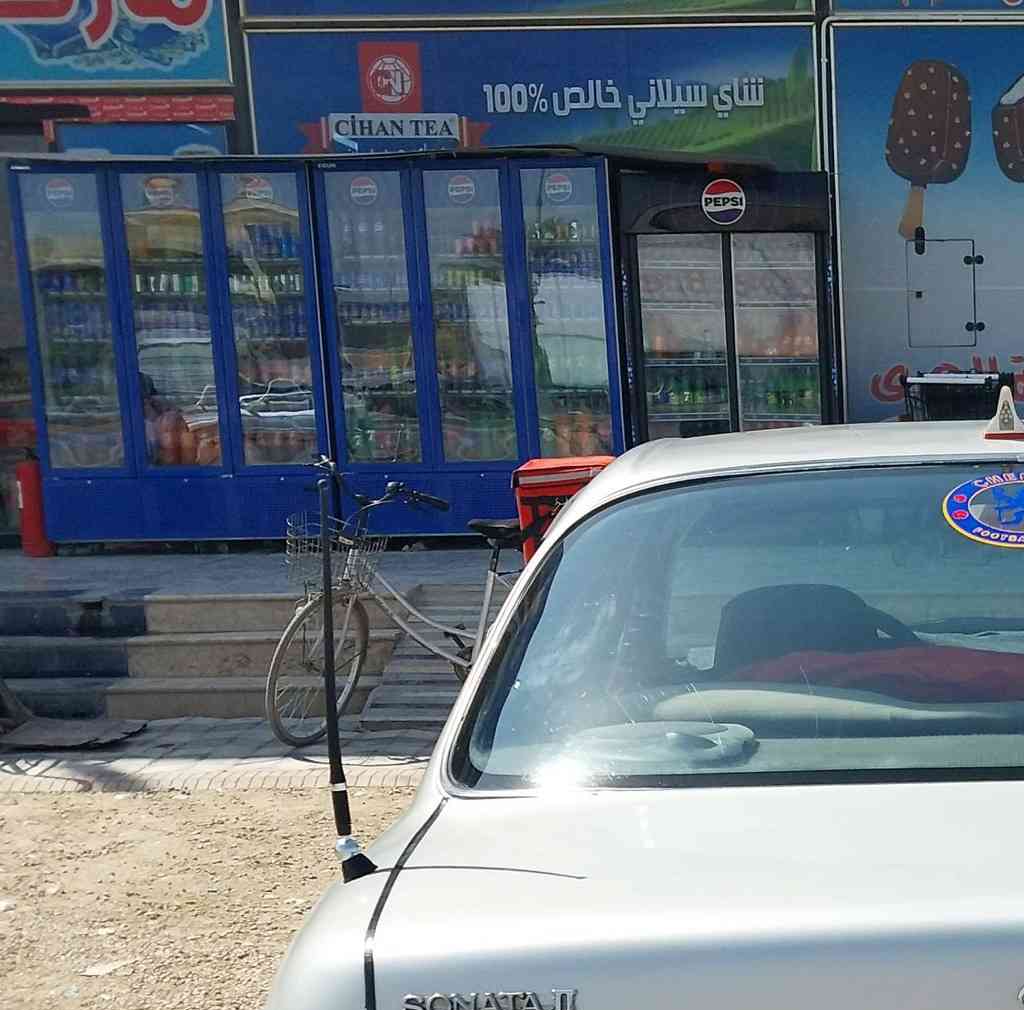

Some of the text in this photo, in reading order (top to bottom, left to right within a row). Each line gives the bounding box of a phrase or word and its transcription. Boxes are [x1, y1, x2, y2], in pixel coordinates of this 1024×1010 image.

[482, 75, 765, 126] شاي سيلاني خالص 100%
[409, 119, 454, 137] TEA
[704, 196, 743, 207] PEPSI
